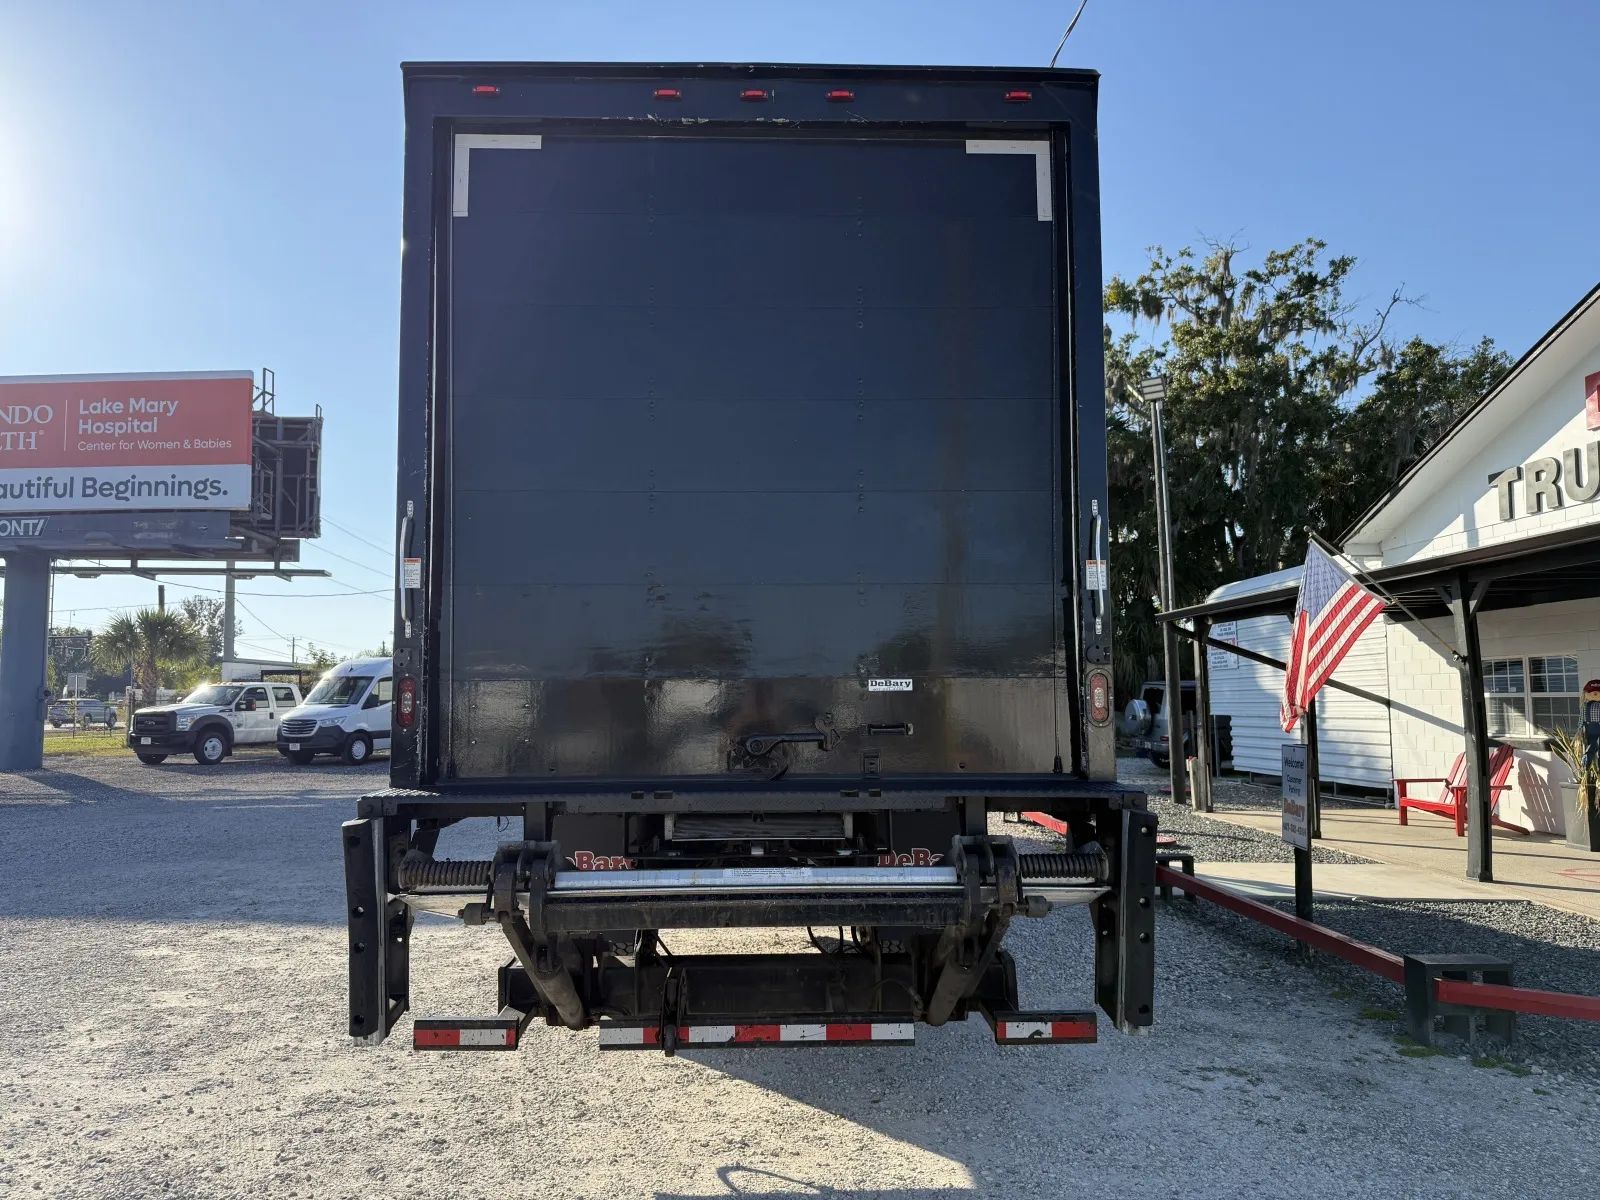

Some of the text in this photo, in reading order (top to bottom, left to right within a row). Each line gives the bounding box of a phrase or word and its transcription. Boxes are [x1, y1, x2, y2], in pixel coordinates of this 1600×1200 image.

[79, 397, 179, 416] Lake Mary
[78, 417, 158, 437] Hospital
[77, 438, 232, 451] Center for Women & Babies
[81, 473, 229, 502] Beginnings.
[1487, 440, 1600, 522] TRU
[870, 680, 912, 688] DeBary
